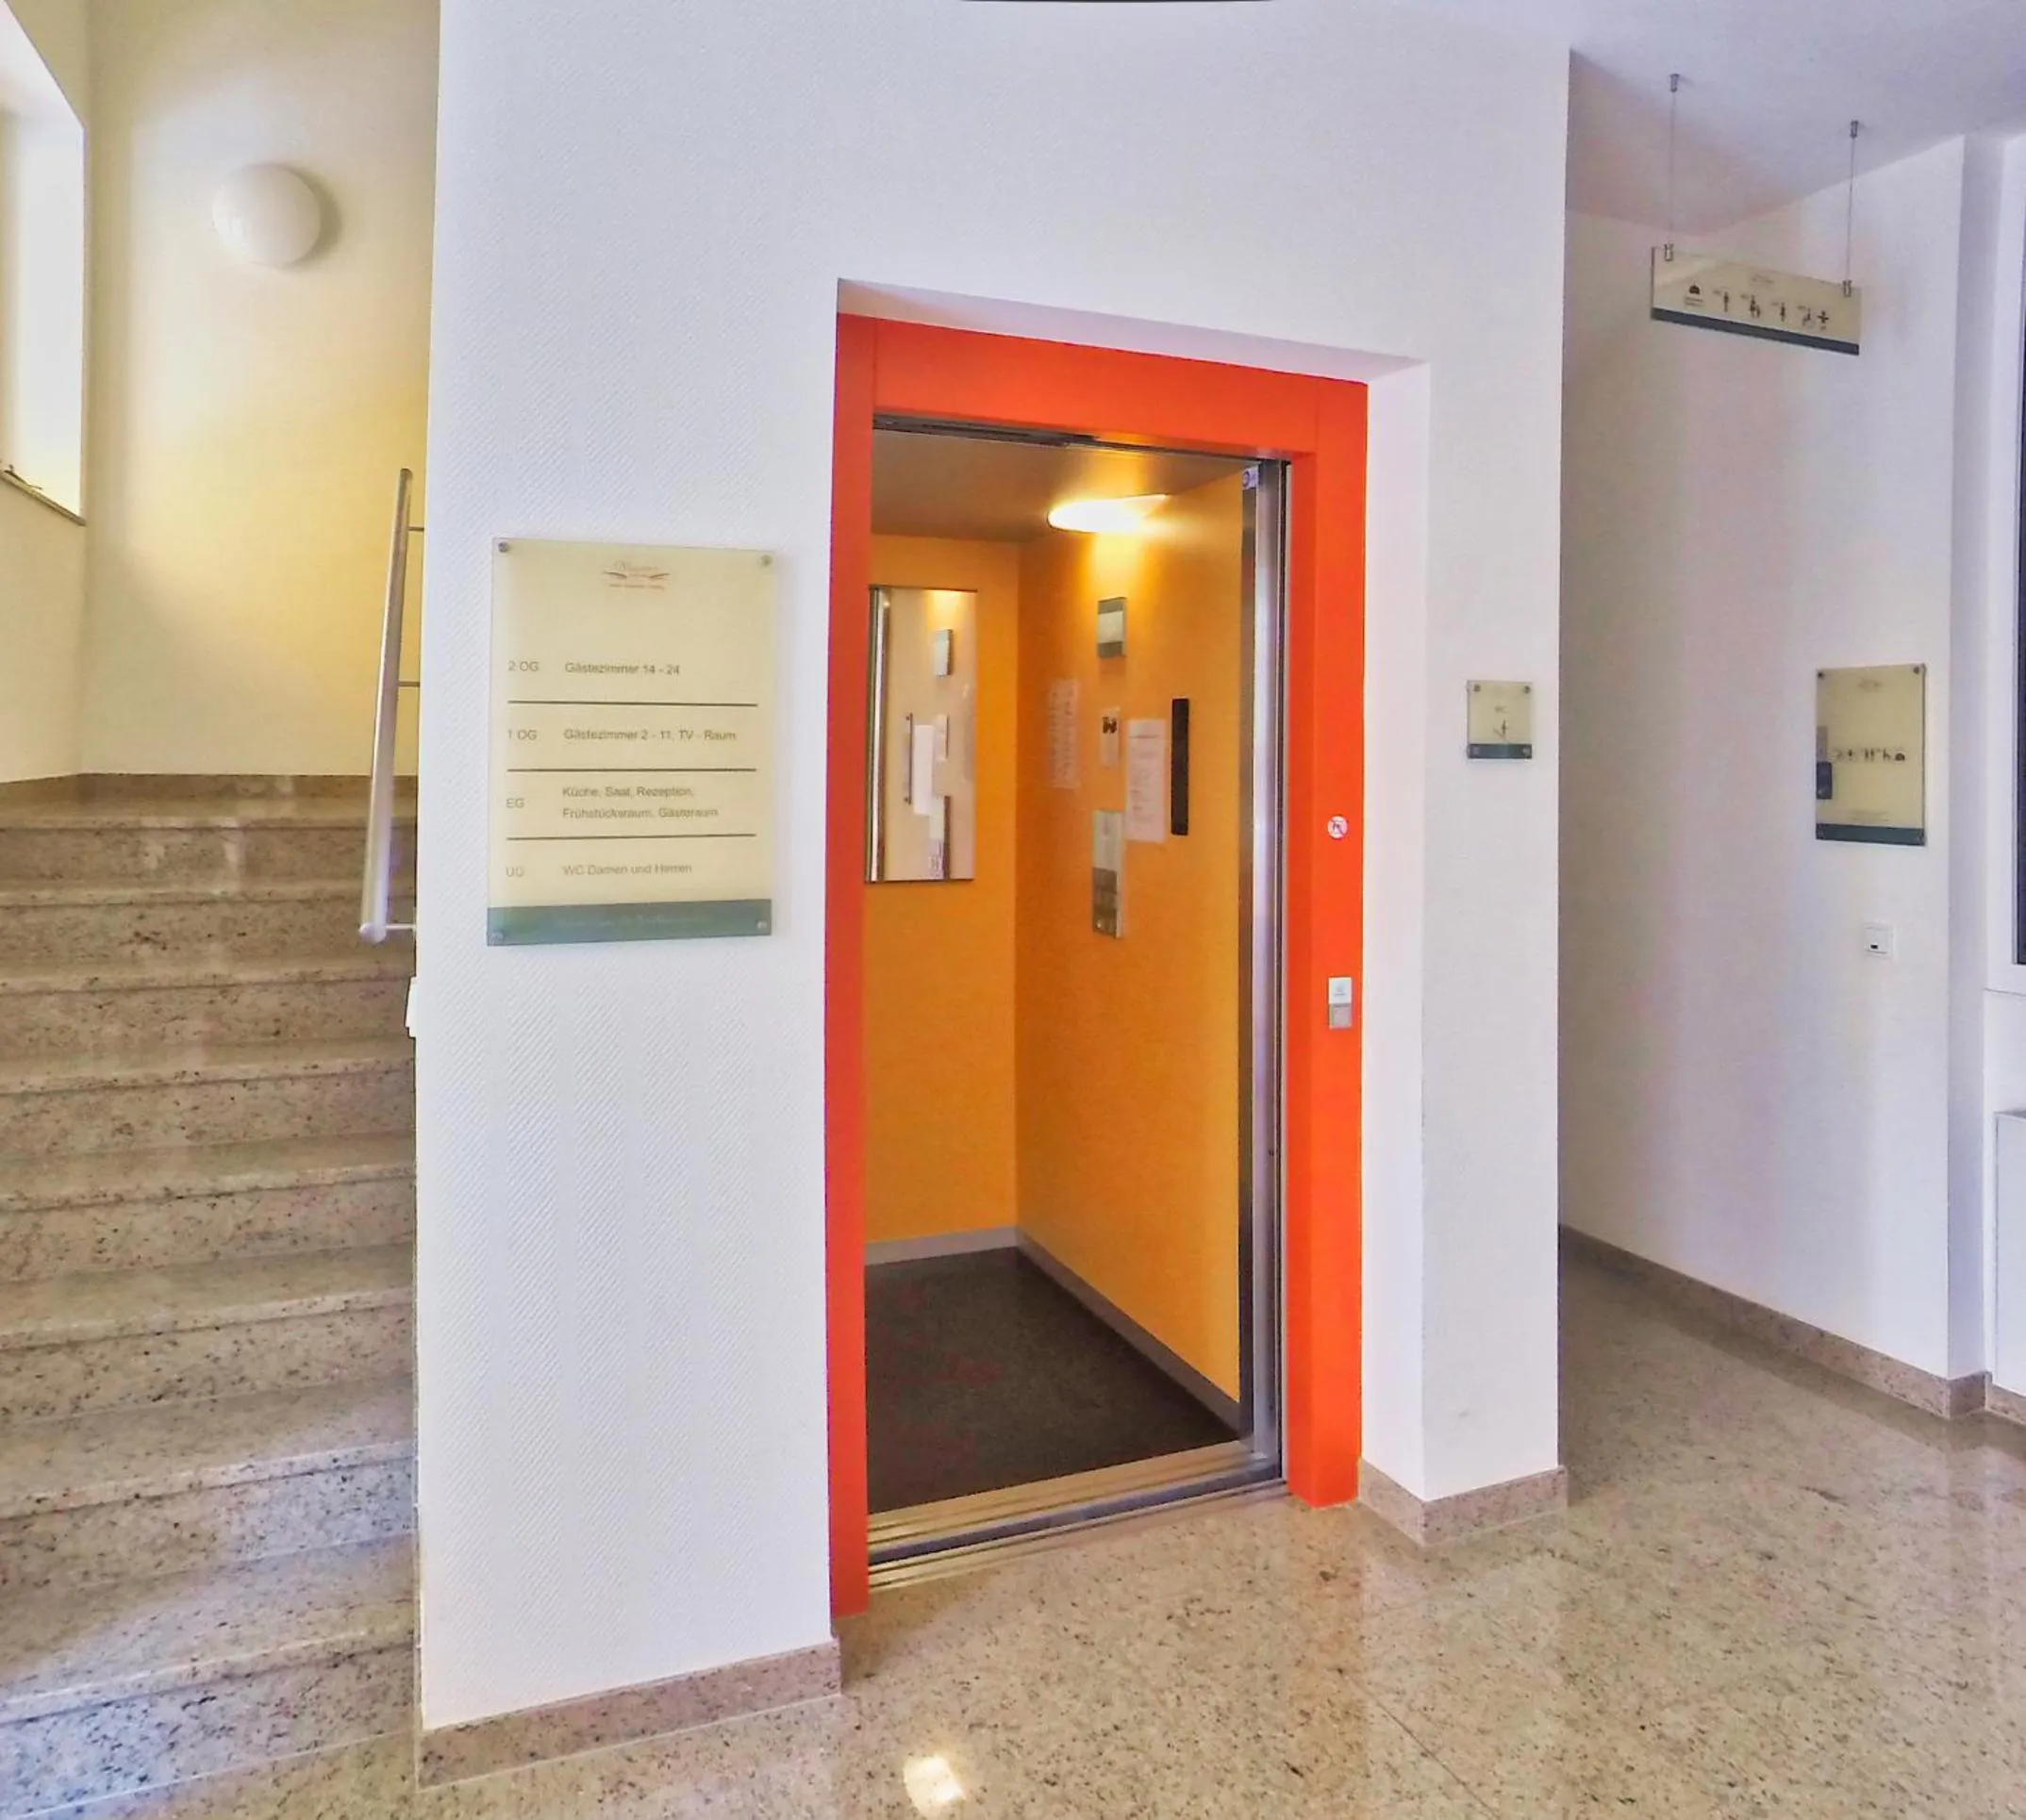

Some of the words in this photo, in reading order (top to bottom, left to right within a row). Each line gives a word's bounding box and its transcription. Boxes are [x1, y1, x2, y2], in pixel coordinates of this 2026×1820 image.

[519, 661, 540, 672] OG
[564, 661, 639, 674] Gästezimmer
[666, 664, 681, 676] 24
[518, 730, 539, 740] OG
[563, 728, 639, 741] Gästezimmer
[640, 730, 649, 740] 2
[679, 730, 694, 740] TV
[704, 730, 737, 741] Raum
[636, 786, 695, 800] Rezeption,
[506, 798, 525, 809] EG
[588, 864, 628, 876] Damen
[631, 864, 653, 875] und
